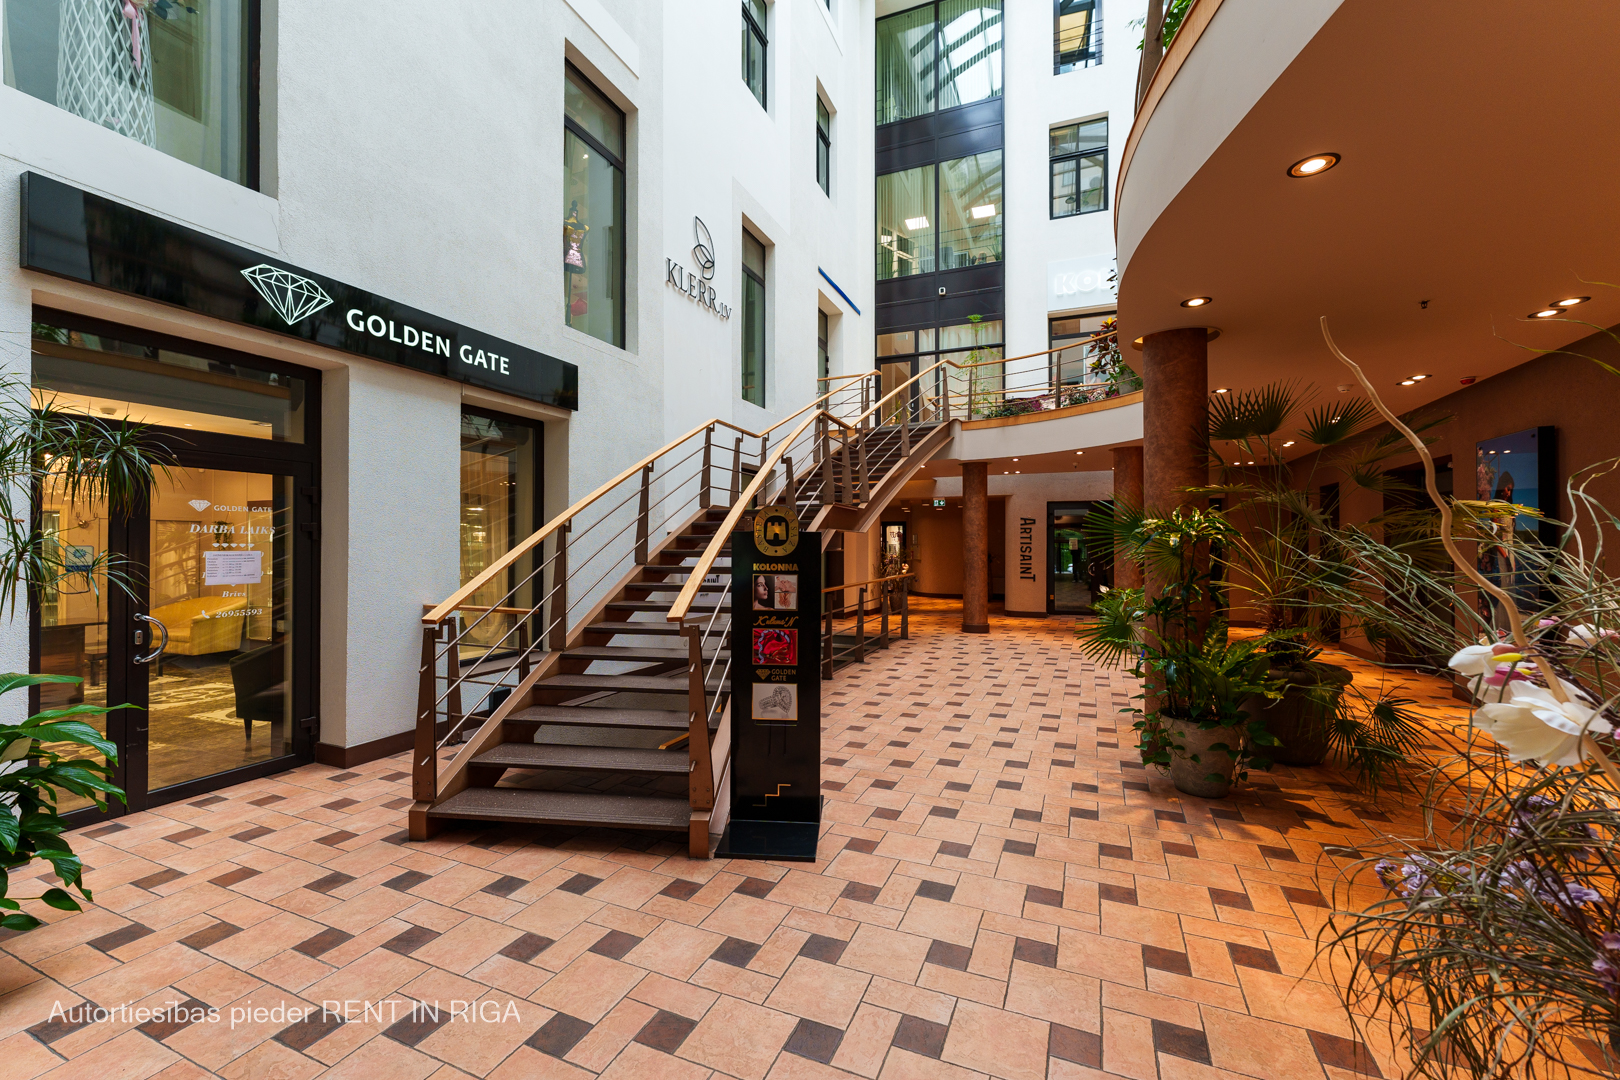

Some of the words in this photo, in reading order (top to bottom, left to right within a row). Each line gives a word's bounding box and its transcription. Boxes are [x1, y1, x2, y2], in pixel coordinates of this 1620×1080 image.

[665, 257, 733, 320] KLERR.LV
[346, 308, 451, 358] GOLDEN
[459, 344, 510, 376] GATE
[189, 524, 236, 534] DARBA
[240, 525, 276, 534] LAIKS
[752, 563, 799, 572] KOLONNA
[215, 608, 262, 618] 26955593
